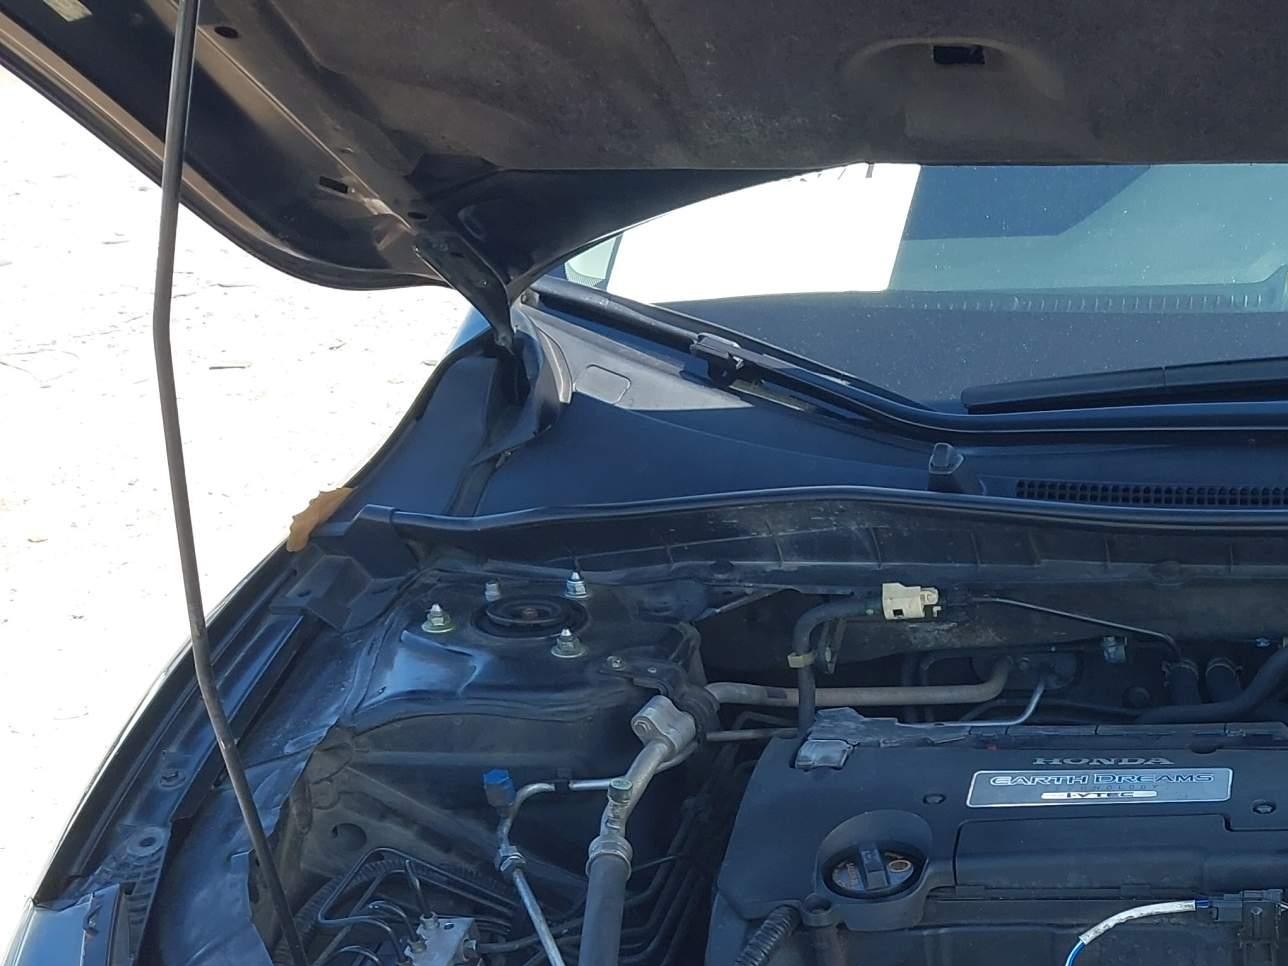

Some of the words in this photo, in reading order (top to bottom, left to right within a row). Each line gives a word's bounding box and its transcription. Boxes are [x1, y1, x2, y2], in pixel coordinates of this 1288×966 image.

[1032, 756, 1175, 766] HONDA
[989, 774, 1090, 787] EARTH
[1093, 772, 1215, 786] DREAMS
